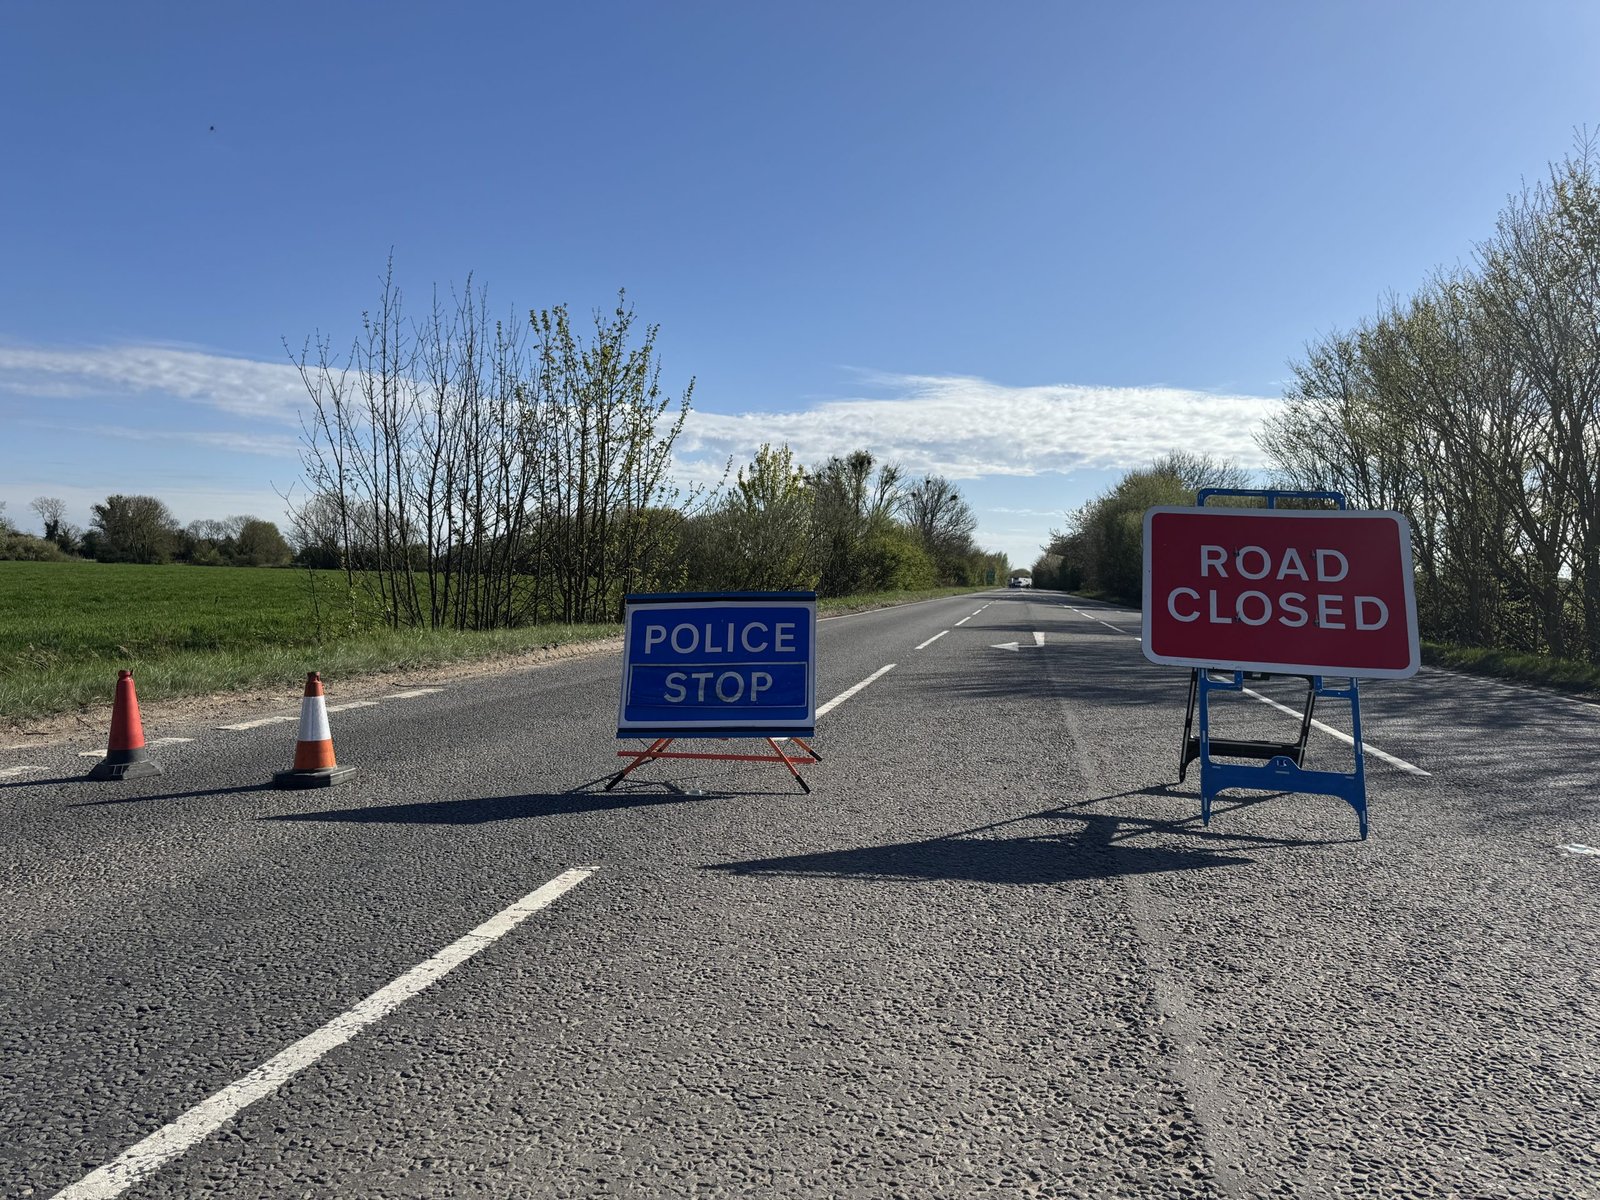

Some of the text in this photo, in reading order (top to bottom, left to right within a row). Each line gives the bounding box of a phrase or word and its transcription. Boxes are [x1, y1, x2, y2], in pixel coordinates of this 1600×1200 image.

[1200, 544, 1349, 583] ROAD
[1166, 587, 1389, 631] CLOSED
[644, 622, 796, 654] POLICE
[663, 671, 773, 703] STOP
